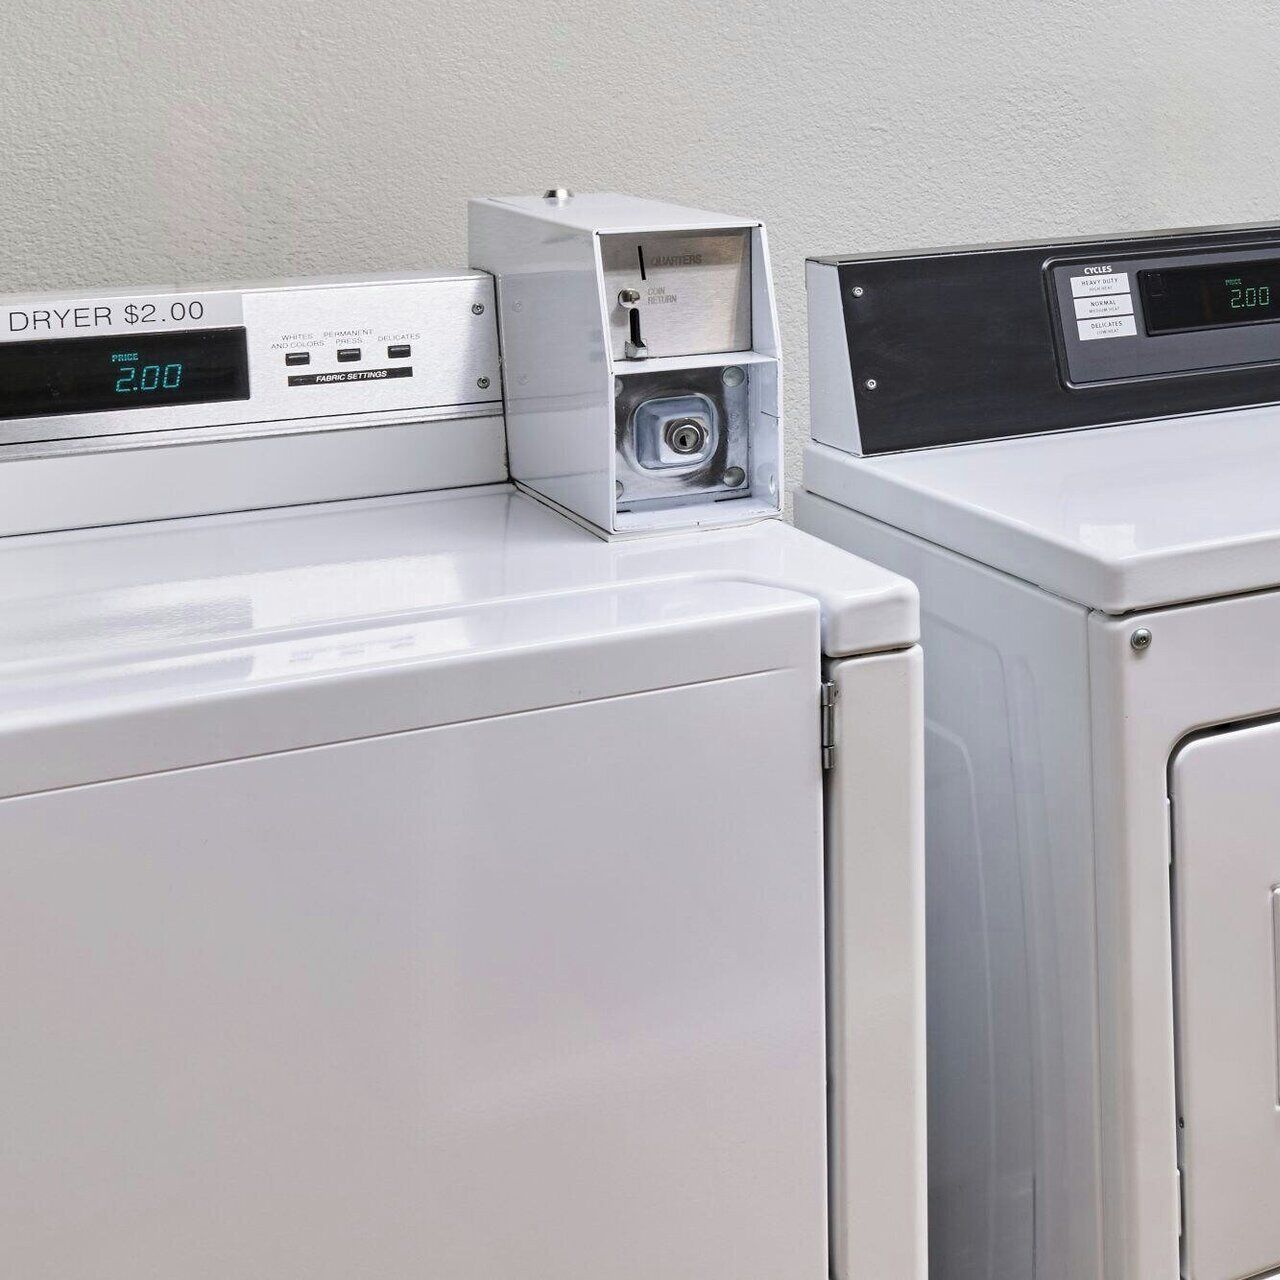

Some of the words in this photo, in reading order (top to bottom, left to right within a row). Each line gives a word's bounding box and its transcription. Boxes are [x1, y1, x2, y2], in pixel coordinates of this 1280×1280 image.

[1084, 265, 1112, 274] CYCLES
[1231, 287, 1269, 308] 2.00
[9, 306, 112, 332] DRYER
[124, 301, 204, 325] $2.00
[1091, 321, 1122, 329] DELICATES
[281, 333, 313, 341] WHITES
[323, 329, 374, 338] PERMANENT
[377, 333, 421, 342] DELICATES
[291, 340, 325, 348] COLORS
[112, 353, 139, 362] PRICE
[116, 364, 182, 392] 2.00
[316, 373, 346, 382] FABRIC
[347, 370, 388, 380] SETTINGS
